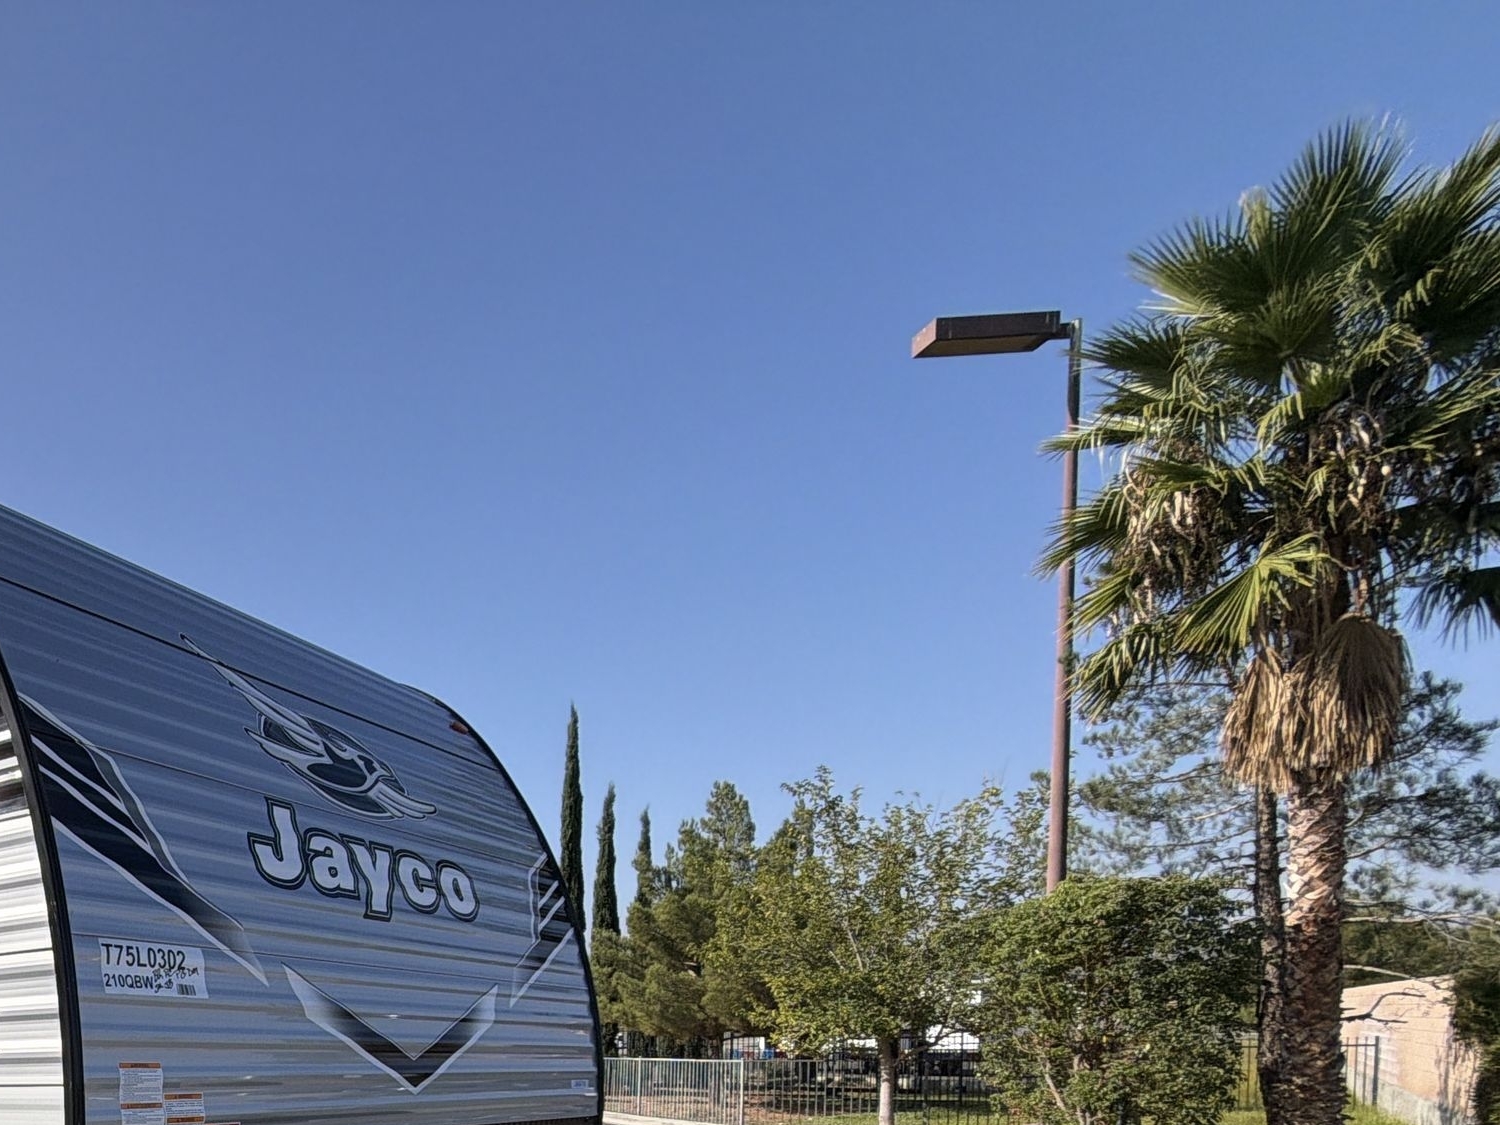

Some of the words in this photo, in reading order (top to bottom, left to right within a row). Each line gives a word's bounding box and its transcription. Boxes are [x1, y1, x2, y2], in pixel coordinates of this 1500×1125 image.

[247, 797, 480, 922] Jayco
[101, 943, 186, 970] T75L0302
[103, 973, 154, 990] 210QBW
